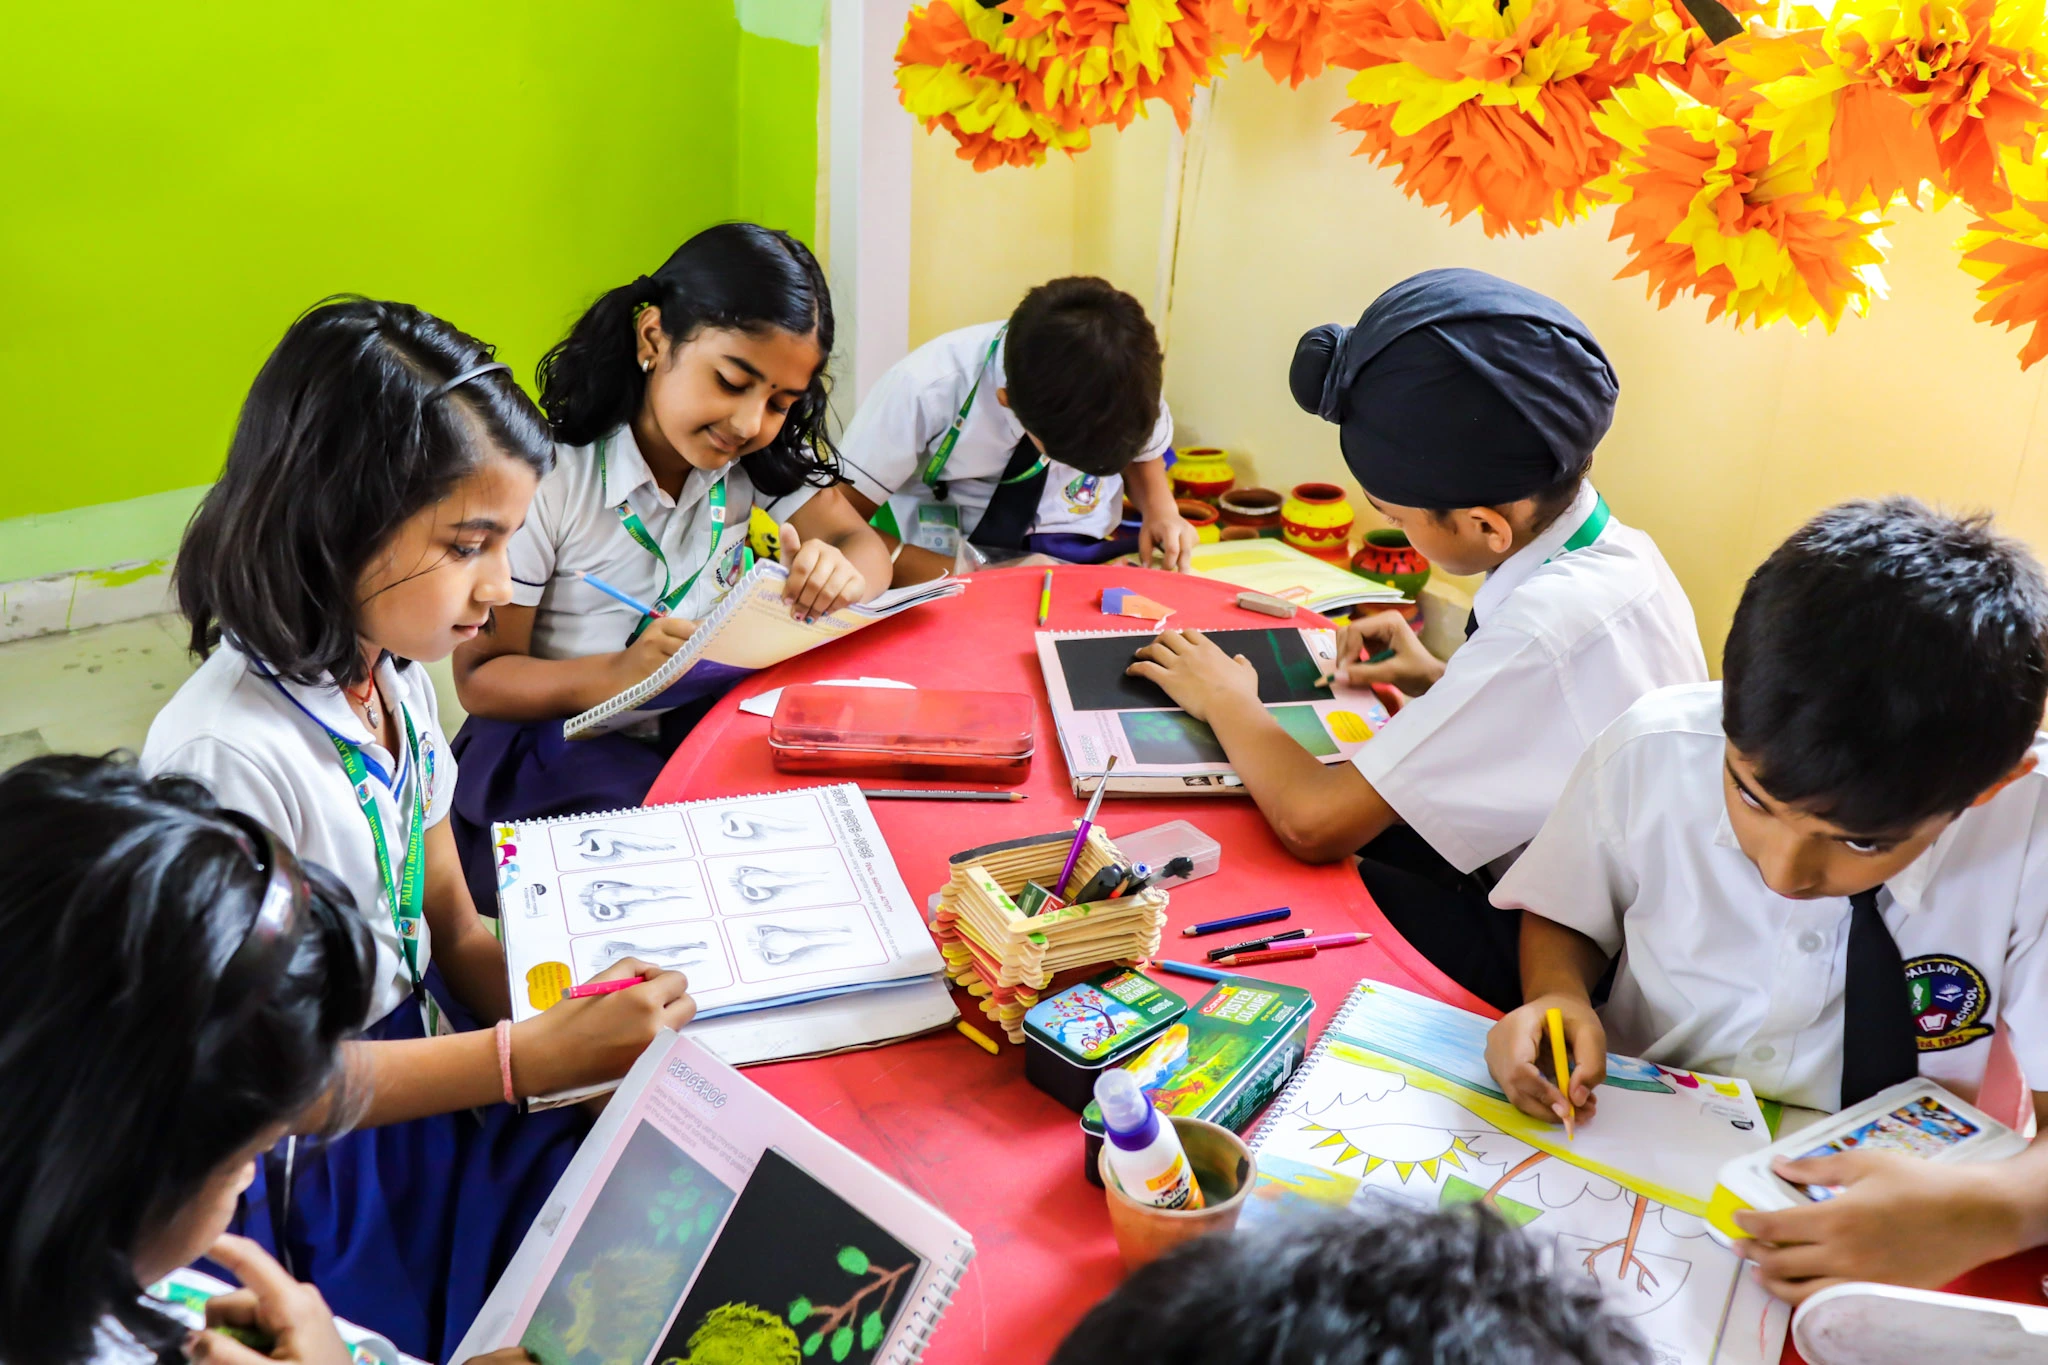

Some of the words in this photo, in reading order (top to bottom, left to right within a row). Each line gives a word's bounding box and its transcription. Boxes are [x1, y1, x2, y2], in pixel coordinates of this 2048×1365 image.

[407, 832, 418, 864] MODEL
[401, 866, 415, 906] PALLAVI
[1111, 977, 1145, 996] POSTER
[1121, 984, 1154, 1001] COLOURS
[1203, 994, 1227, 1013] Camel
[1215, 990, 1257, 1018] POSTER
[1235, 993, 1273, 1022] COLOURS
[1951, 987, 1978, 1027] SCHOOL
[667, 1057, 728, 1109] HEDGEHOG
